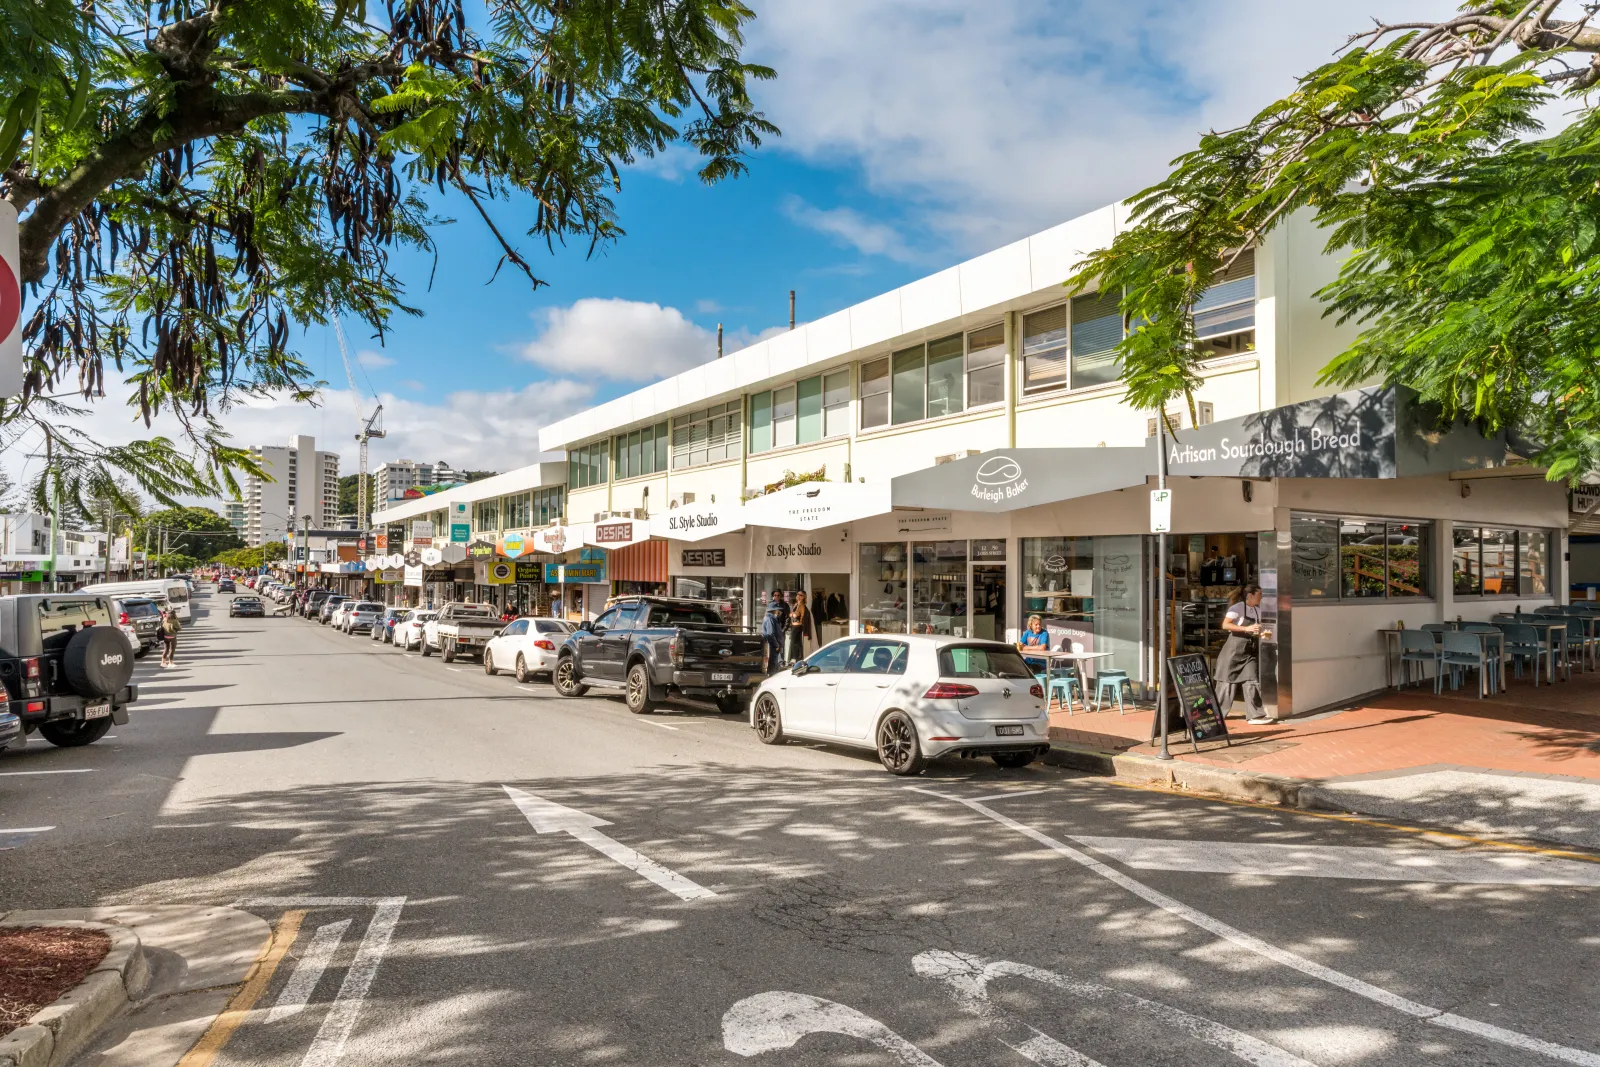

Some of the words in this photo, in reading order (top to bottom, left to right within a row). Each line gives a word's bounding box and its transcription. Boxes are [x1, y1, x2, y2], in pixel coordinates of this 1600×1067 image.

[1169, 443, 1216, 465] Artisan
[1221, 428, 1305, 460] Sourdough
[1311, 421, 1360, 451] Bread
[971, 484, 1004, 504] Burleigh
[1006, 478, 1029, 498] Baker
[670, 517, 678, 530] SL
[679, 516, 695, 532] Style
[696, 512, 718, 527] Studio
[596, 525, 631, 540] DESIRE
[766, 544, 777, 556] SL
[778, 544, 796, 559] Style
[797, 542, 822, 556] Studio
[682, 551, 724, 566] DESIRE
[518, 566, 540, 574] Organic
[1072, 629, 1086, 637] bugs
[101, 654, 122, 666] Jeep
